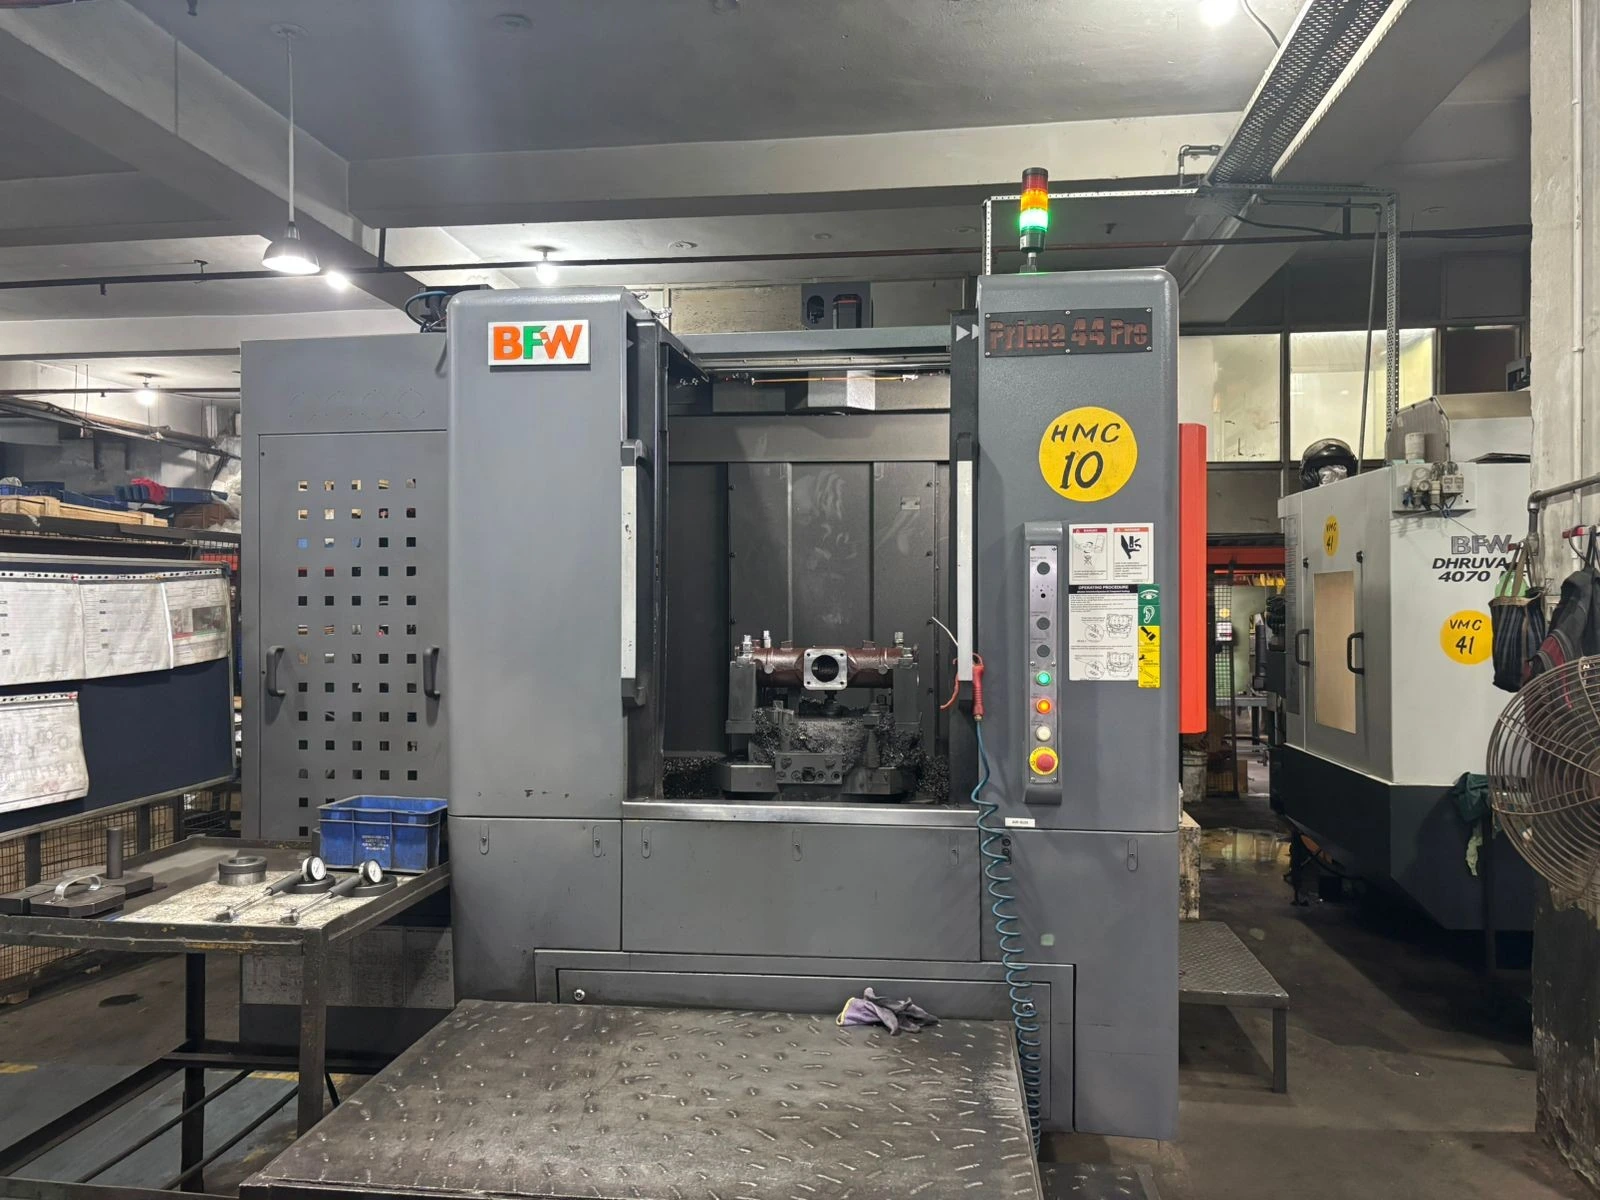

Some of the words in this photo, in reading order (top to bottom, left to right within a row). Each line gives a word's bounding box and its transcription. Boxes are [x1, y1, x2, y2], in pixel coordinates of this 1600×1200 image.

[493, 324, 583, 360] BFW
[989, 320, 1065, 350] Prima
[1071, 317, 1106, 346] 44
[1110, 319, 1148, 345] Pro
[1051, 423, 1121, 443] HMC
[1060, 450, 1104, 489] 10
[1451, 534, 1512, 555] BFW
[1432, 557, 1508, 570] DHRUVA
[1438, 570, 1491, 582] 4070
[1449, 619, 1482, 631] VMC
[1455, 635, 1475, 655] 41
